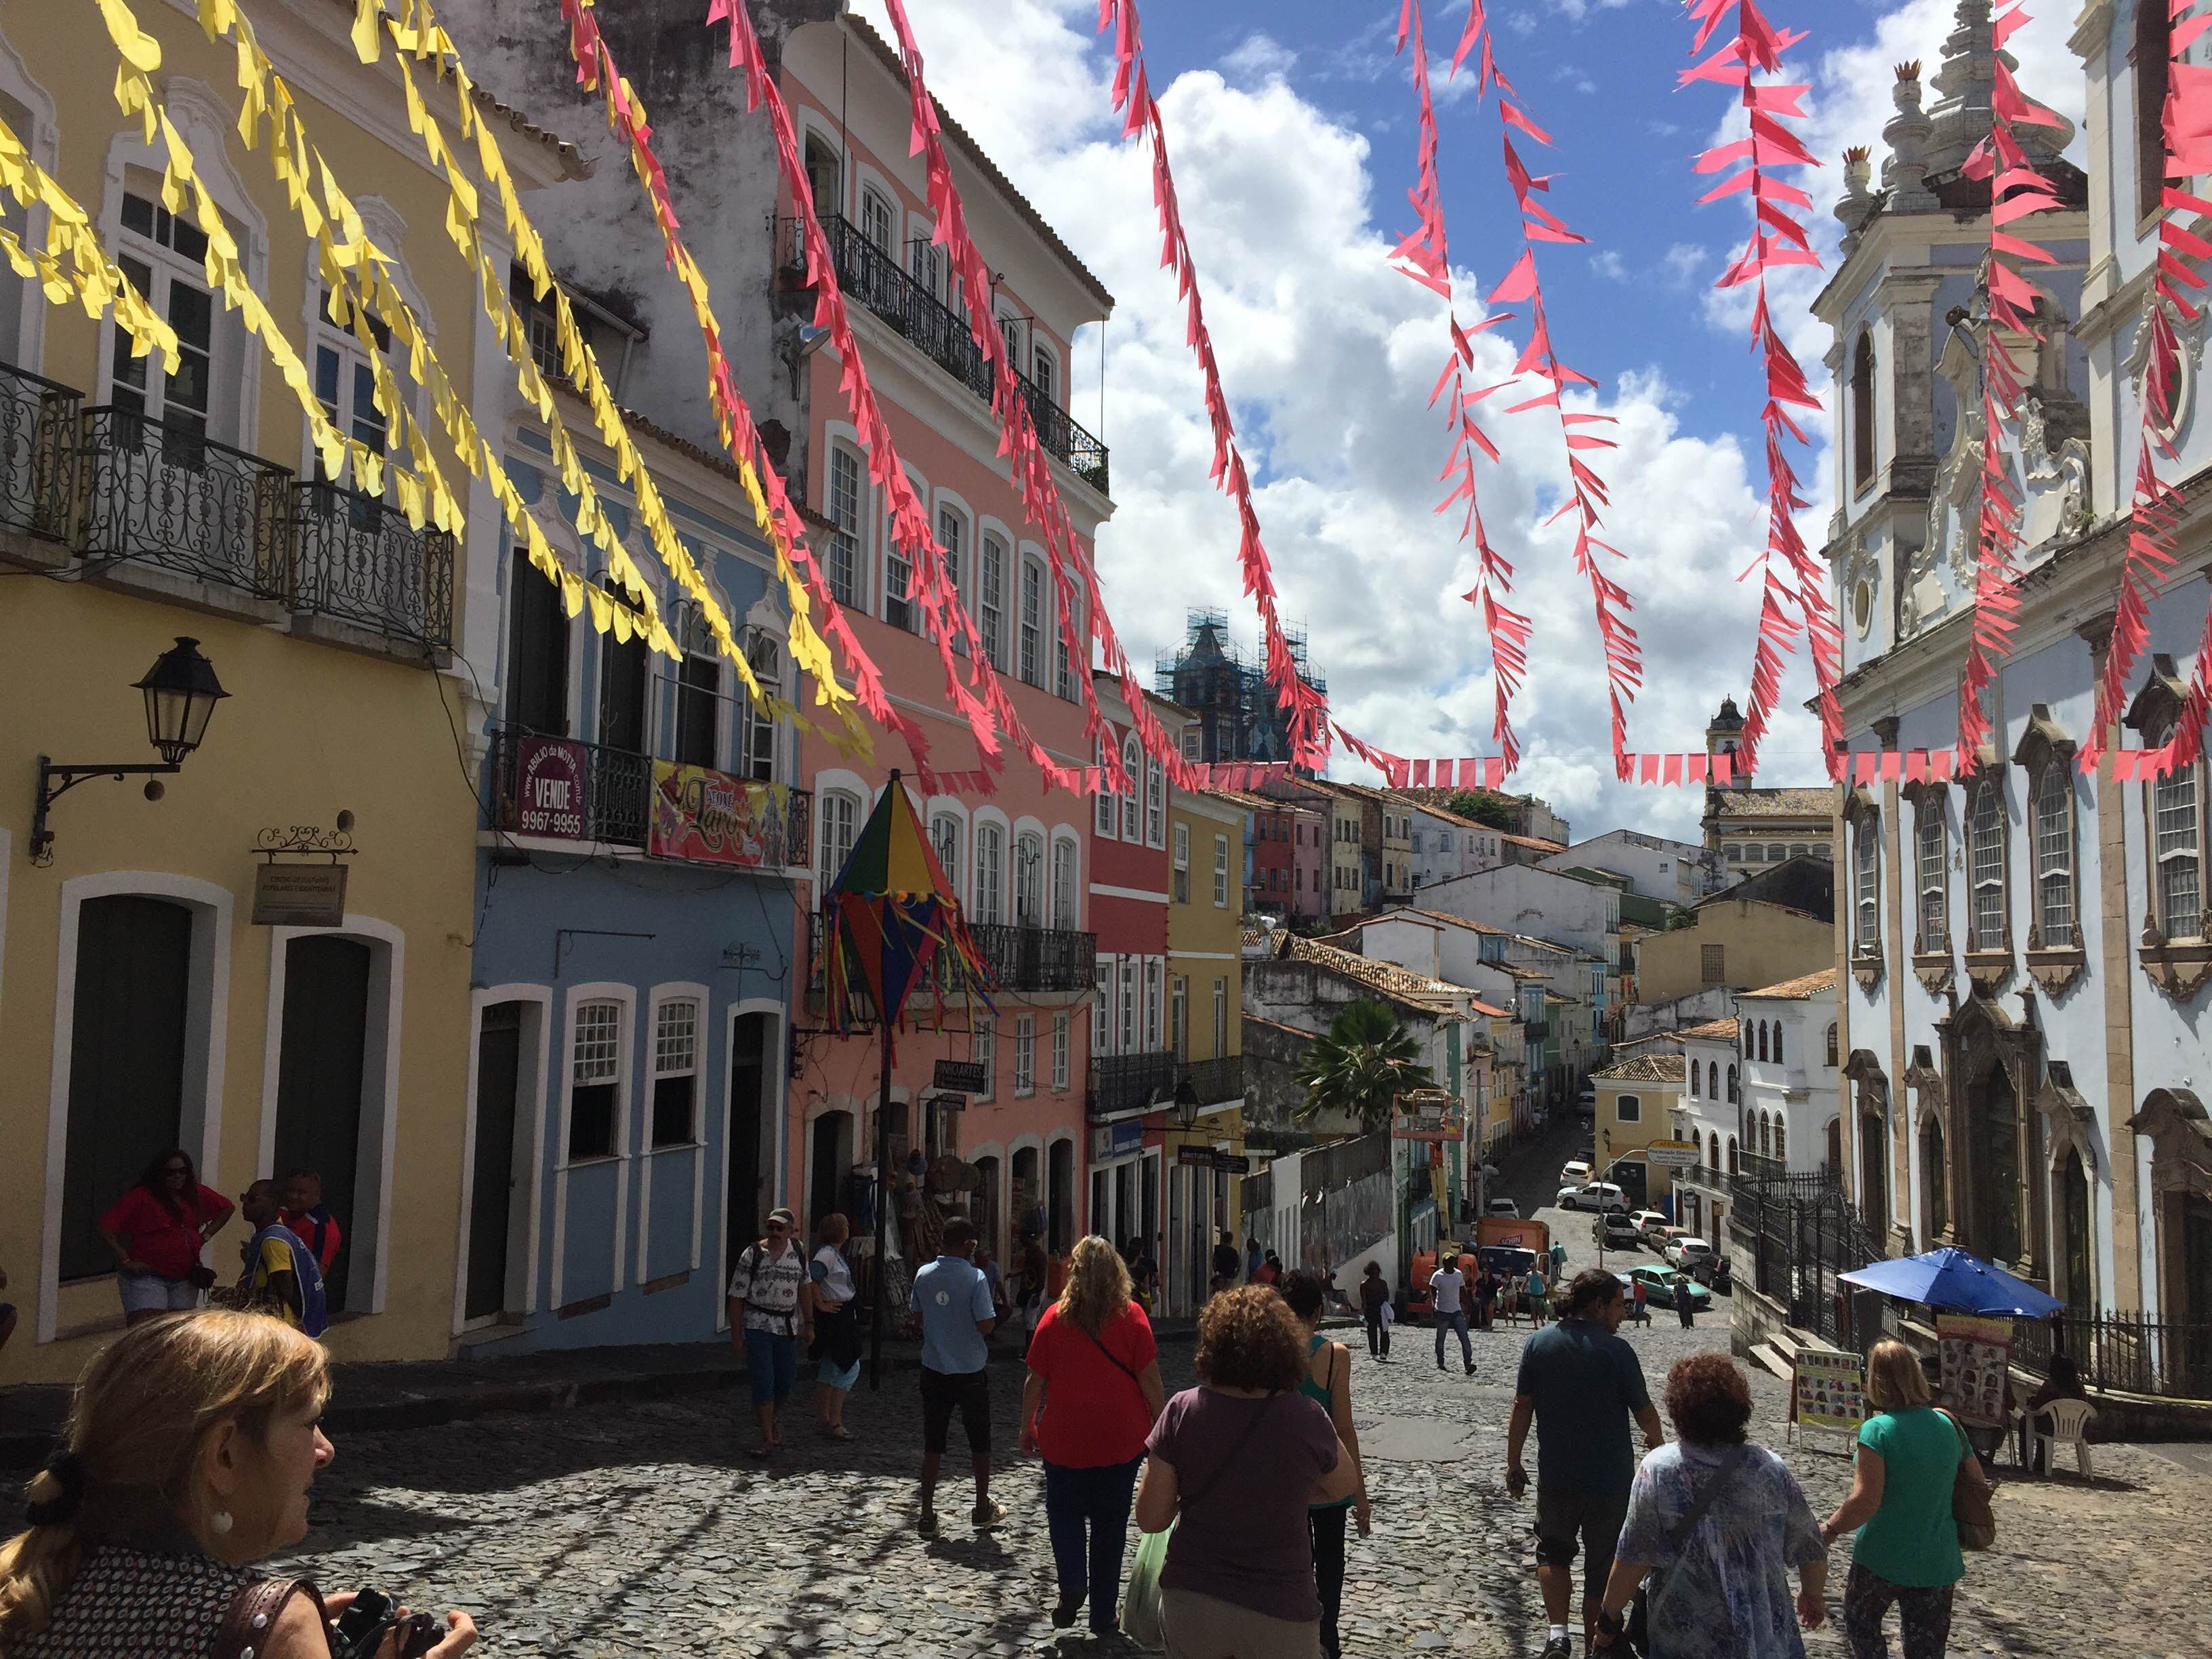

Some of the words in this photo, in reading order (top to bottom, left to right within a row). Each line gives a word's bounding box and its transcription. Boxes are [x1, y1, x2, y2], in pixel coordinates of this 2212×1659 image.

[549, 744, 556, 756] da
[535, 777, 571, 810] VENDE
[522, 810, 581, 834] 9967-9955
[959, 1064, 983, 1078] ARTES
